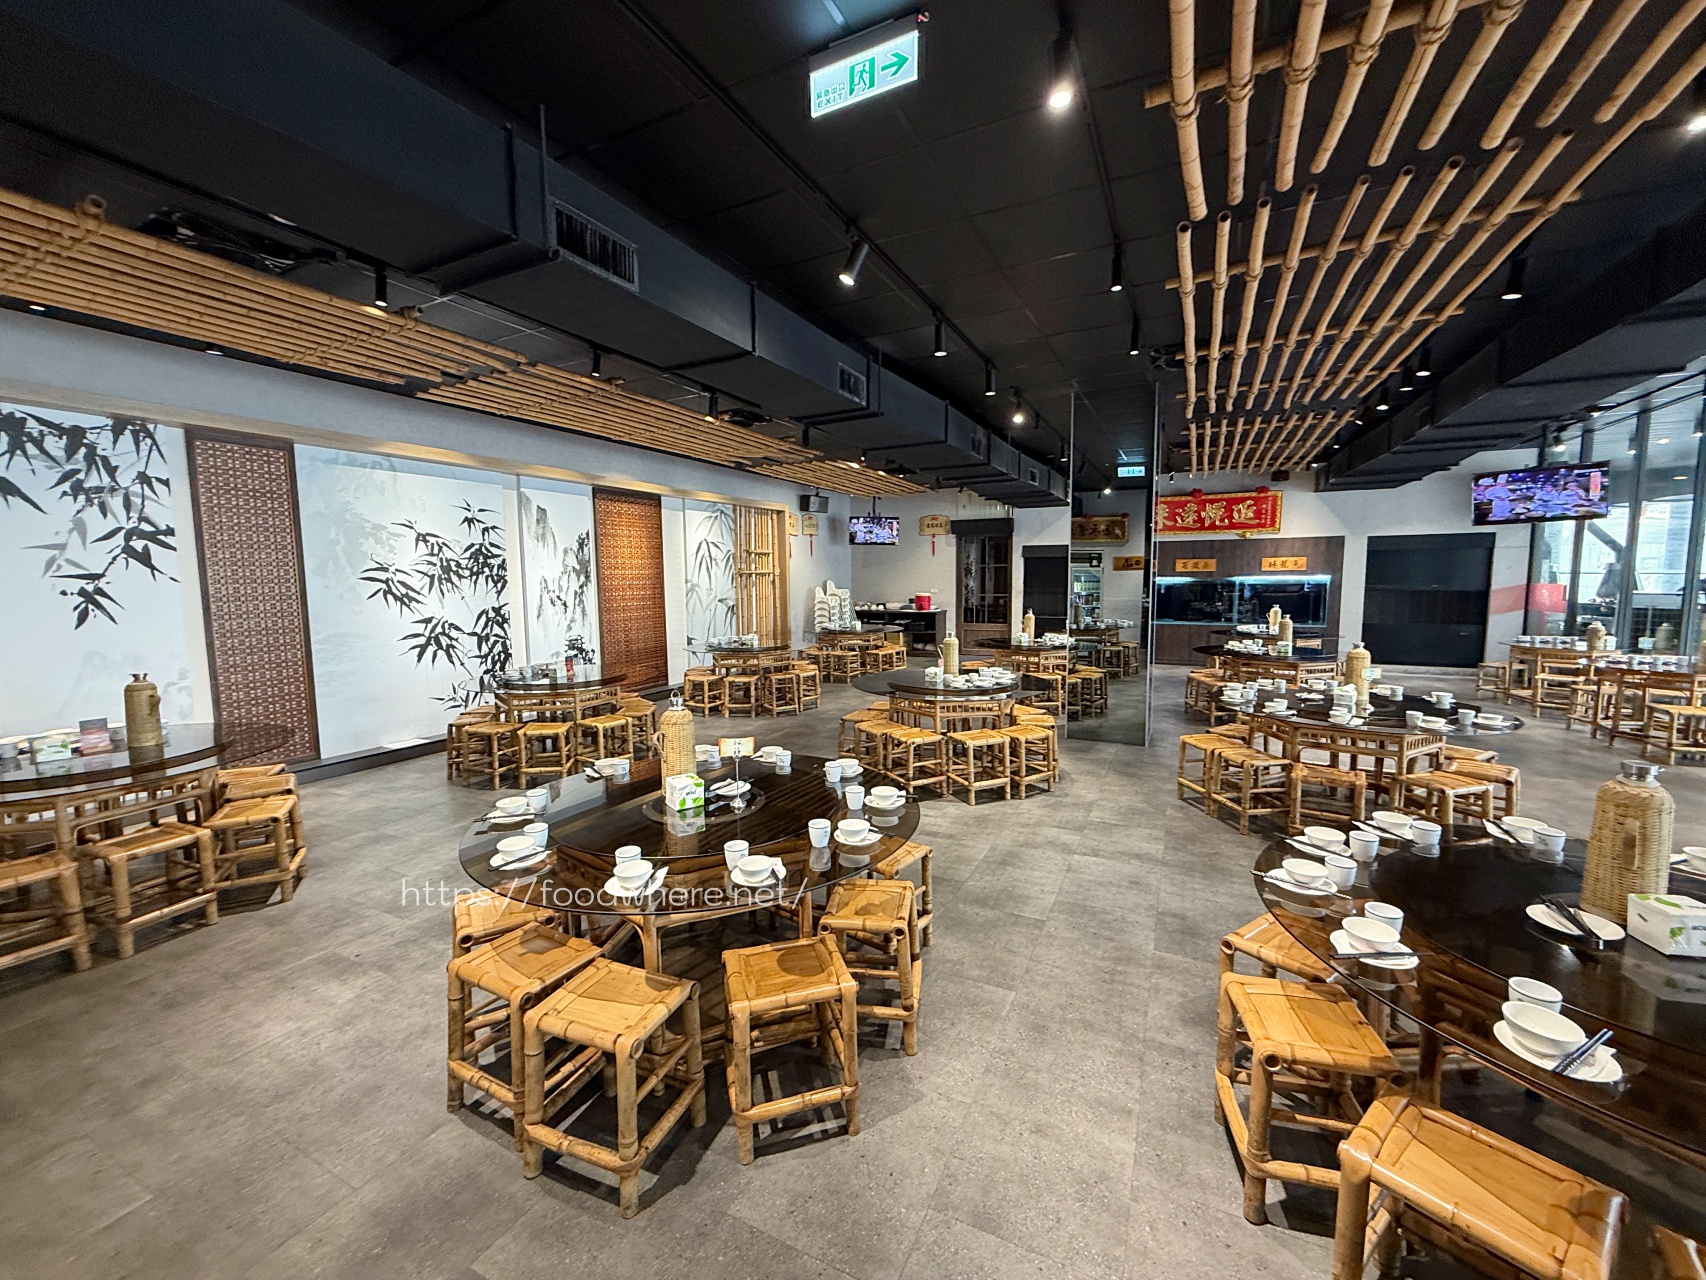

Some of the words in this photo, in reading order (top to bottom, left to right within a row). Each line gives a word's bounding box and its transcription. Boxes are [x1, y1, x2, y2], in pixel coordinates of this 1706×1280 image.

[816, 82, 845, 99] 緊急出口
[817, 93, 843, 108] EXIT
